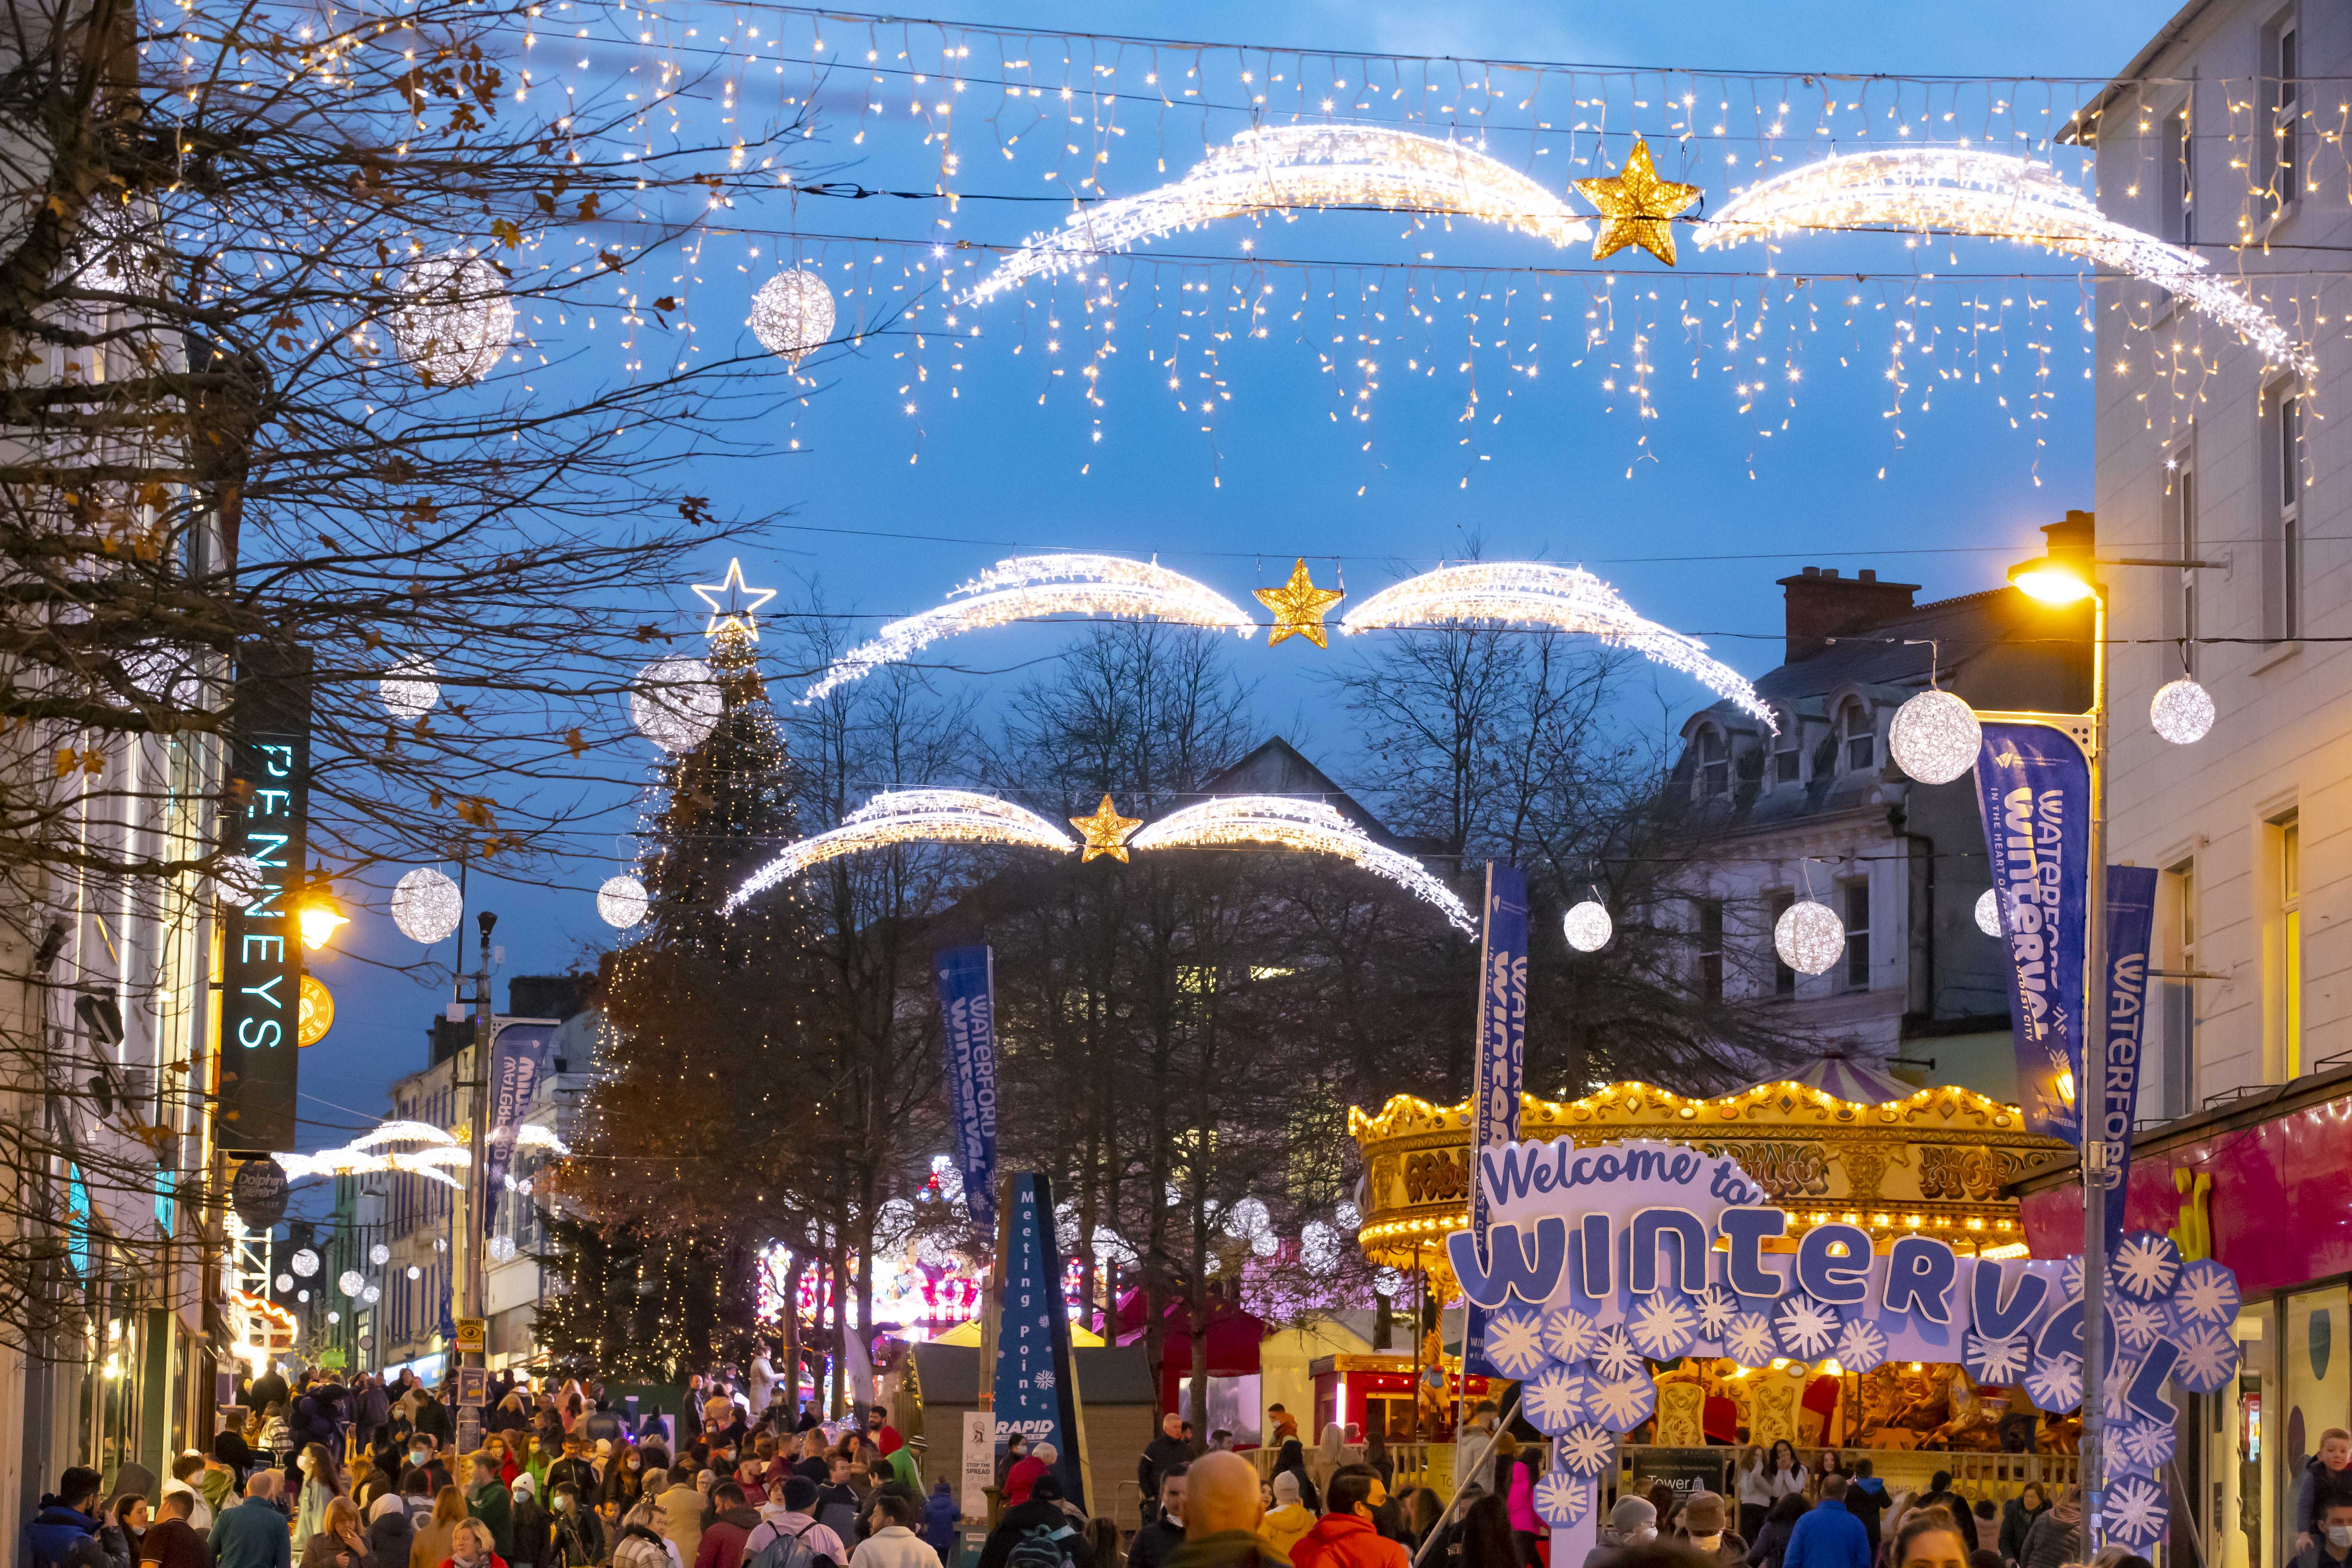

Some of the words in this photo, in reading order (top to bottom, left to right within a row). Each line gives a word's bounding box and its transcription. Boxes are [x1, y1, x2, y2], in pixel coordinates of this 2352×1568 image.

[1991, 787, 1999, 800] IN
[1992, 806, 2002, 828] THE
[1994, 833, 2005, 873] HEART
[239, 745, 292, 1048] PENNEYS
[2003, 787, 2049, 1041] WINTERVAL
[2036, 790, 2064, 990] WATERFO
[1488, 946, 1494, 961] IN
[1483, 999, 1491, 1046] HEART
[1490, 950, 1510, 1150] WINTER
[2023, 1015, 2034, 1041] CITY
[950, 997, 986, 1173] WINTERVAL
[969, 995, 996, 1137] WATERFORD
[1482, 1052, 1490, 1071] OF
[2104, 953, 2144, 1191] WATERFORD
[1479, 1076, 1490, 1145] IRELAND'
[238, 1173, 284, 1188] Dolphin
[1482, 1140, 1701, 1206] Welcome
[1710, 1161, 1759, 1205] to
[1020, 1191, 1034, 1307] Meeting
[1475, 1219, 1484, 1253] CITY
[1446, 1205, 2183, 1428] WINTERVAL
[1019, 1325, 1030, 1406] Point
[995, 1420, 1055, 1434] RAPID
[1647, 1475, 1690, 1489] Tower
